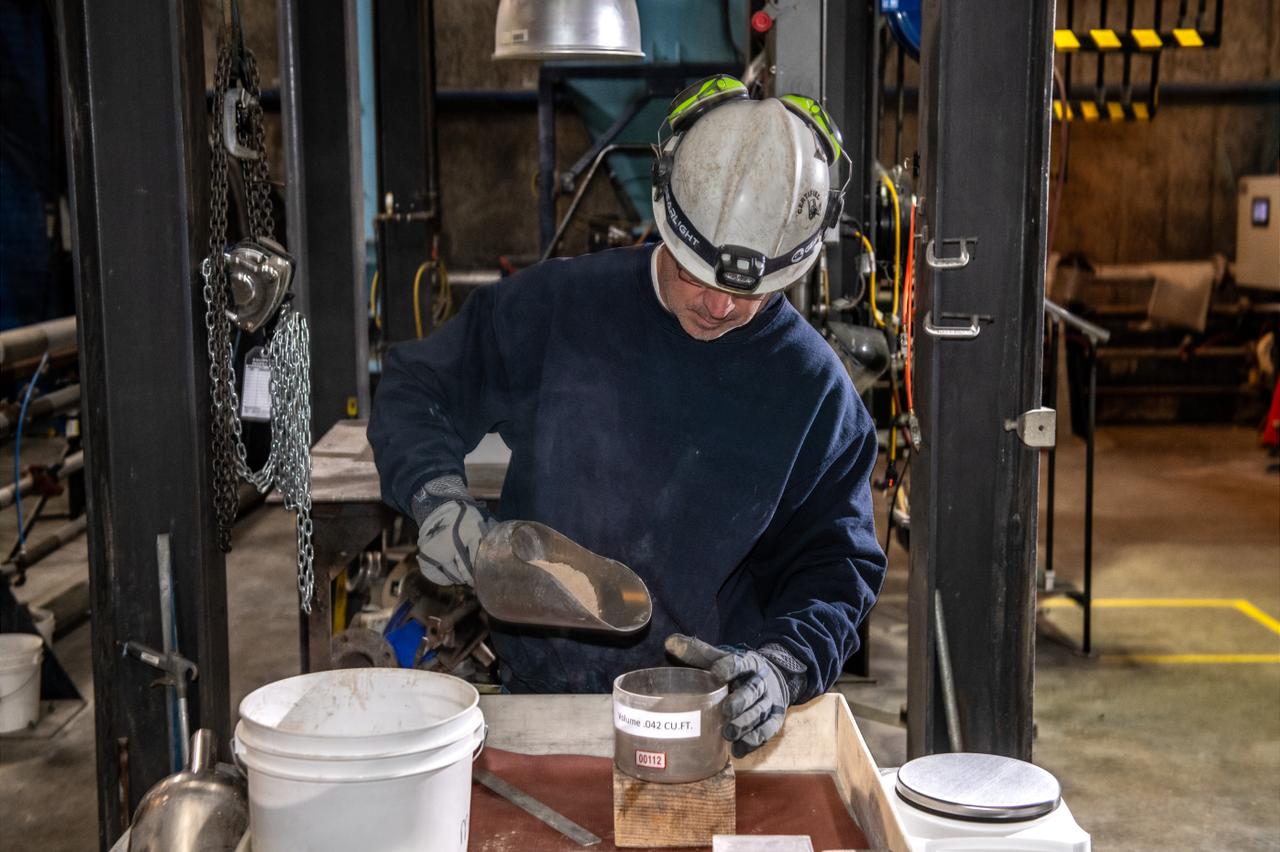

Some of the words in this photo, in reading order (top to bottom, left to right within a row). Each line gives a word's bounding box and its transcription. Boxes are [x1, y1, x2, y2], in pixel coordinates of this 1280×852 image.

[618, 711, 641, 727] Volume
[643, 720, 661, 730] .042
[664, 721, 693, 730] CU.FT.
[639, 754, 662, 765] 00112
